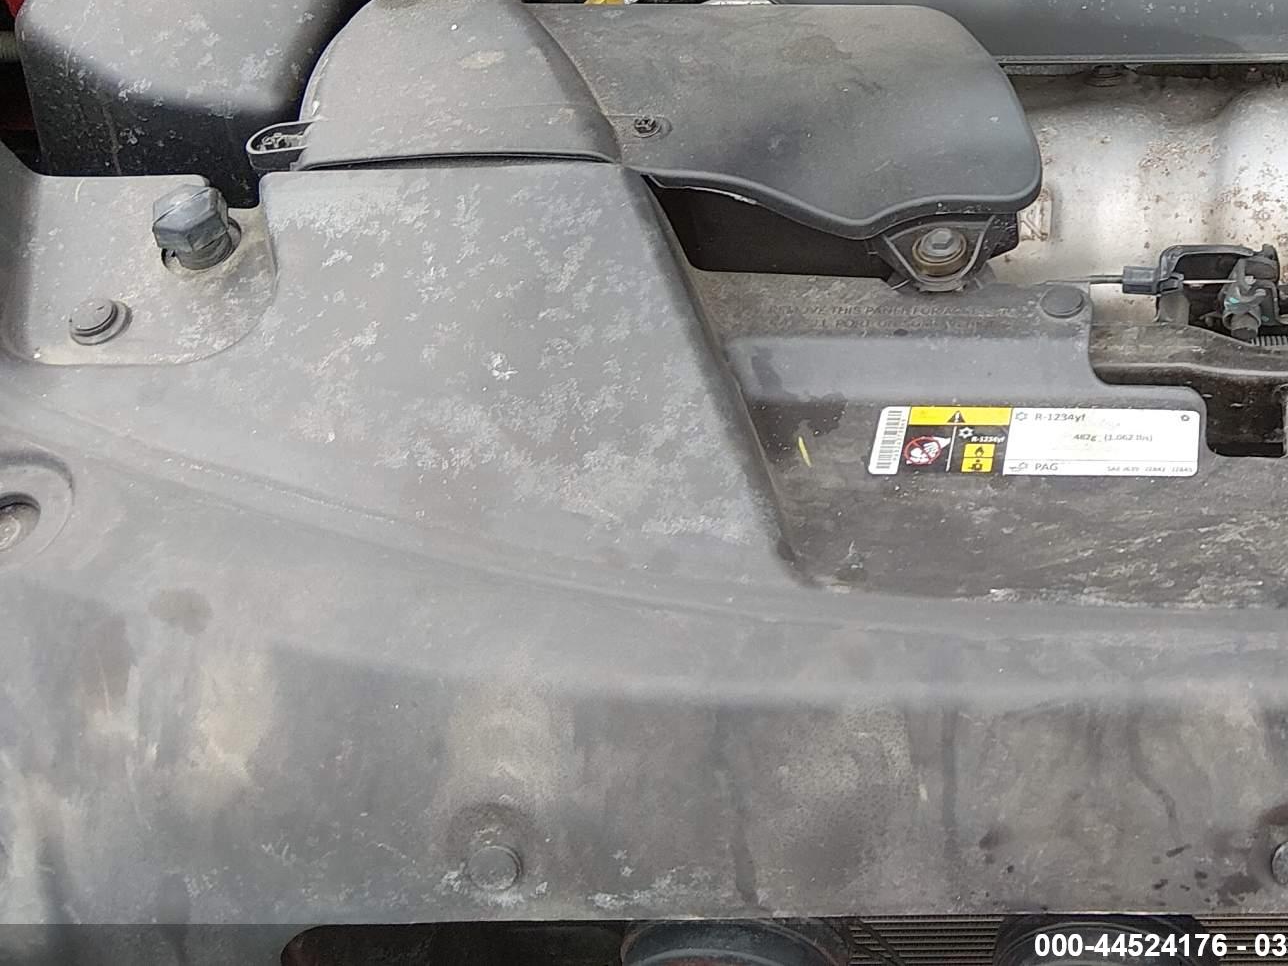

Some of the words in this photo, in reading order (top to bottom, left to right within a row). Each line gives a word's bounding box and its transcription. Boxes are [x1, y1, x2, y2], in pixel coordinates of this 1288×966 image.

[831, 306, 861, 315] THIS
[1034, 413, 1086, 423] R-1234yf
[1034, 462, 1059, 472] PAG
